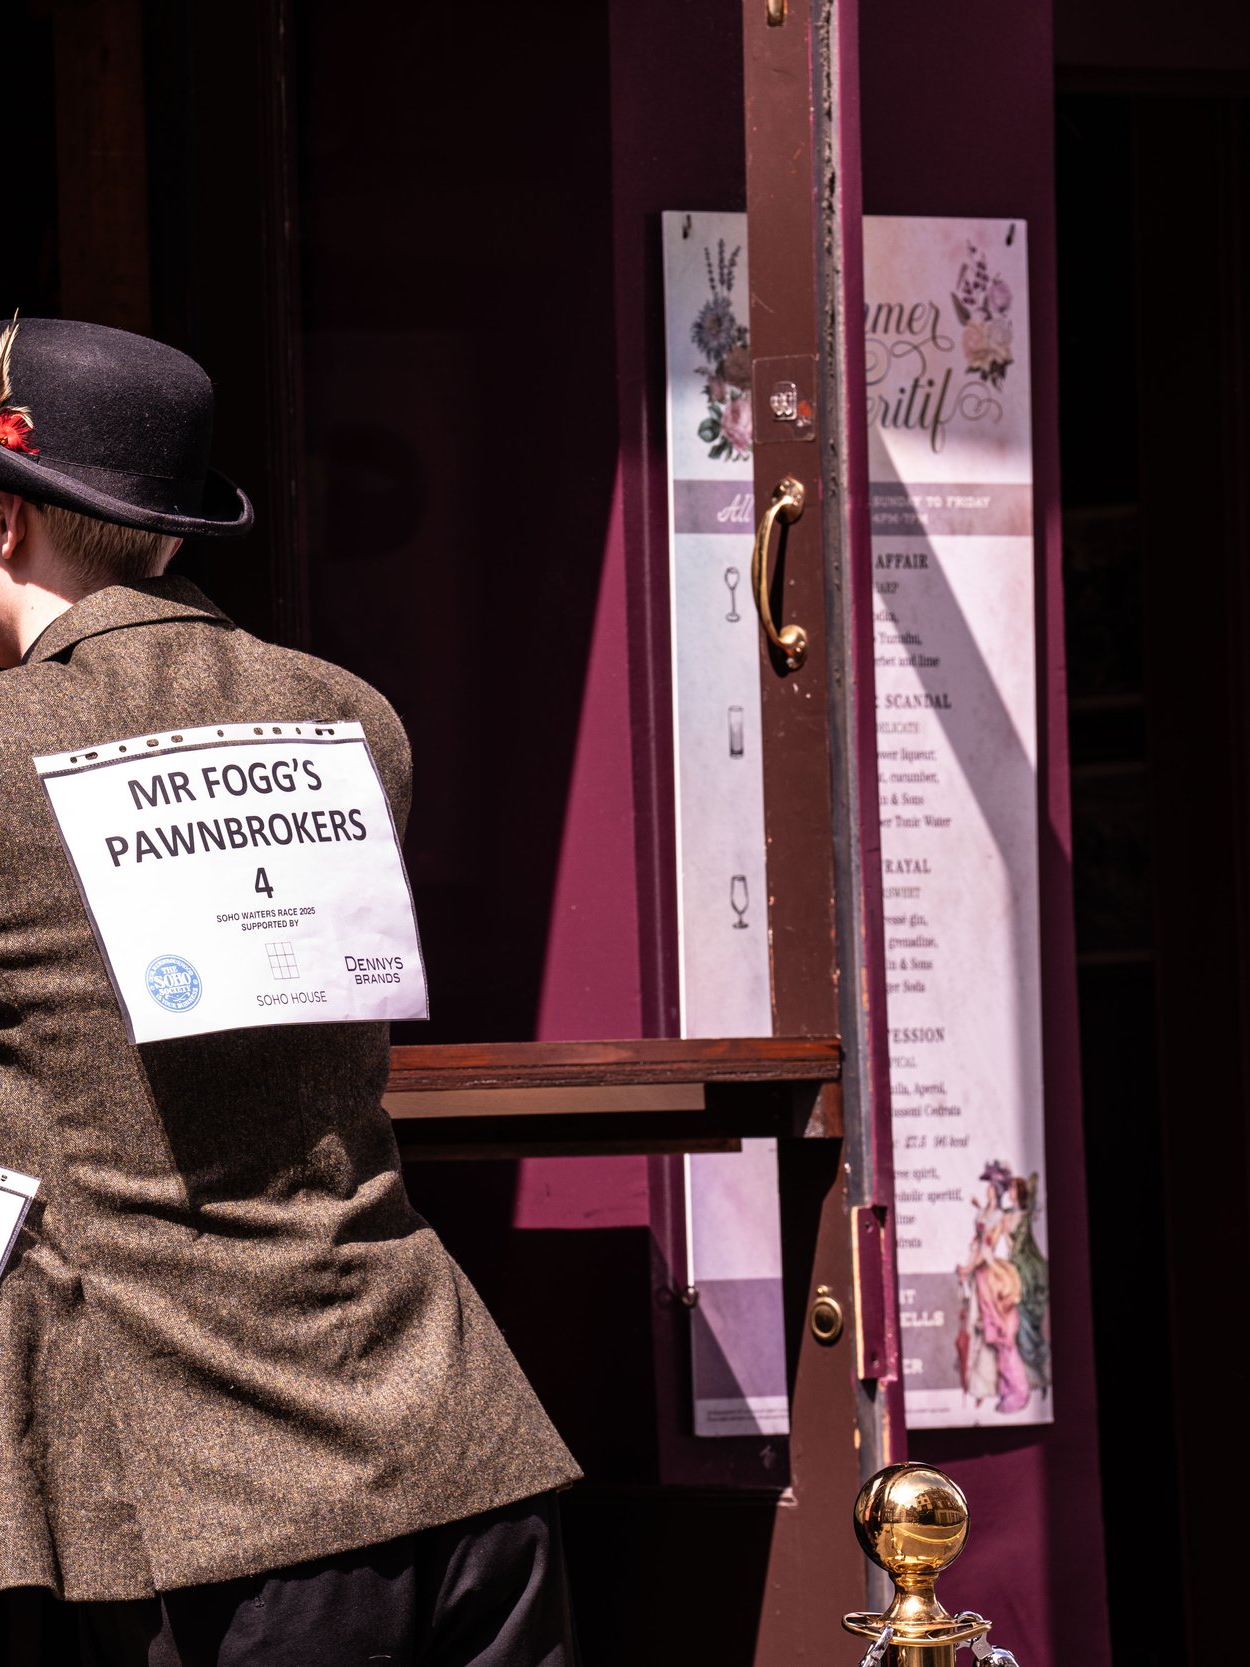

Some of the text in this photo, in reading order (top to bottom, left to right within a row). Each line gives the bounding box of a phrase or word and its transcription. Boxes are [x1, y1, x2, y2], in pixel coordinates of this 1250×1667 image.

[864, 299, 953, 352] mer
[925, 495, 943, 508] TO
[946, 495, 991, 509] FRIDAY
[875, 553, 929, 570] AFFAIR
[918, 652, 940, 667] lime
[885, 693, 951, 709] SCANDAL
[127, 758, 323, 810] MR FOGG'S
[105, 808, 368, 867] PAWNBROKERS
[254, 867, 274, 899] 4
[216, 906, 316, 923] SOHO WAITERS RACE 2025
[241, 919, 299, 931] SUPPORTED BY
[161, 966, 178, 974] THE
[344, 956, 404, 971] DENNYS
[153, 972, 192, 989] SOHO
[354, 973, 401, 984] BRANDS
[159, 985, 191, 996] SOCIETY
[256, 990, 327, 1007] SOHO HOUSE
[889, 1028, 944, 1043] ESSION
